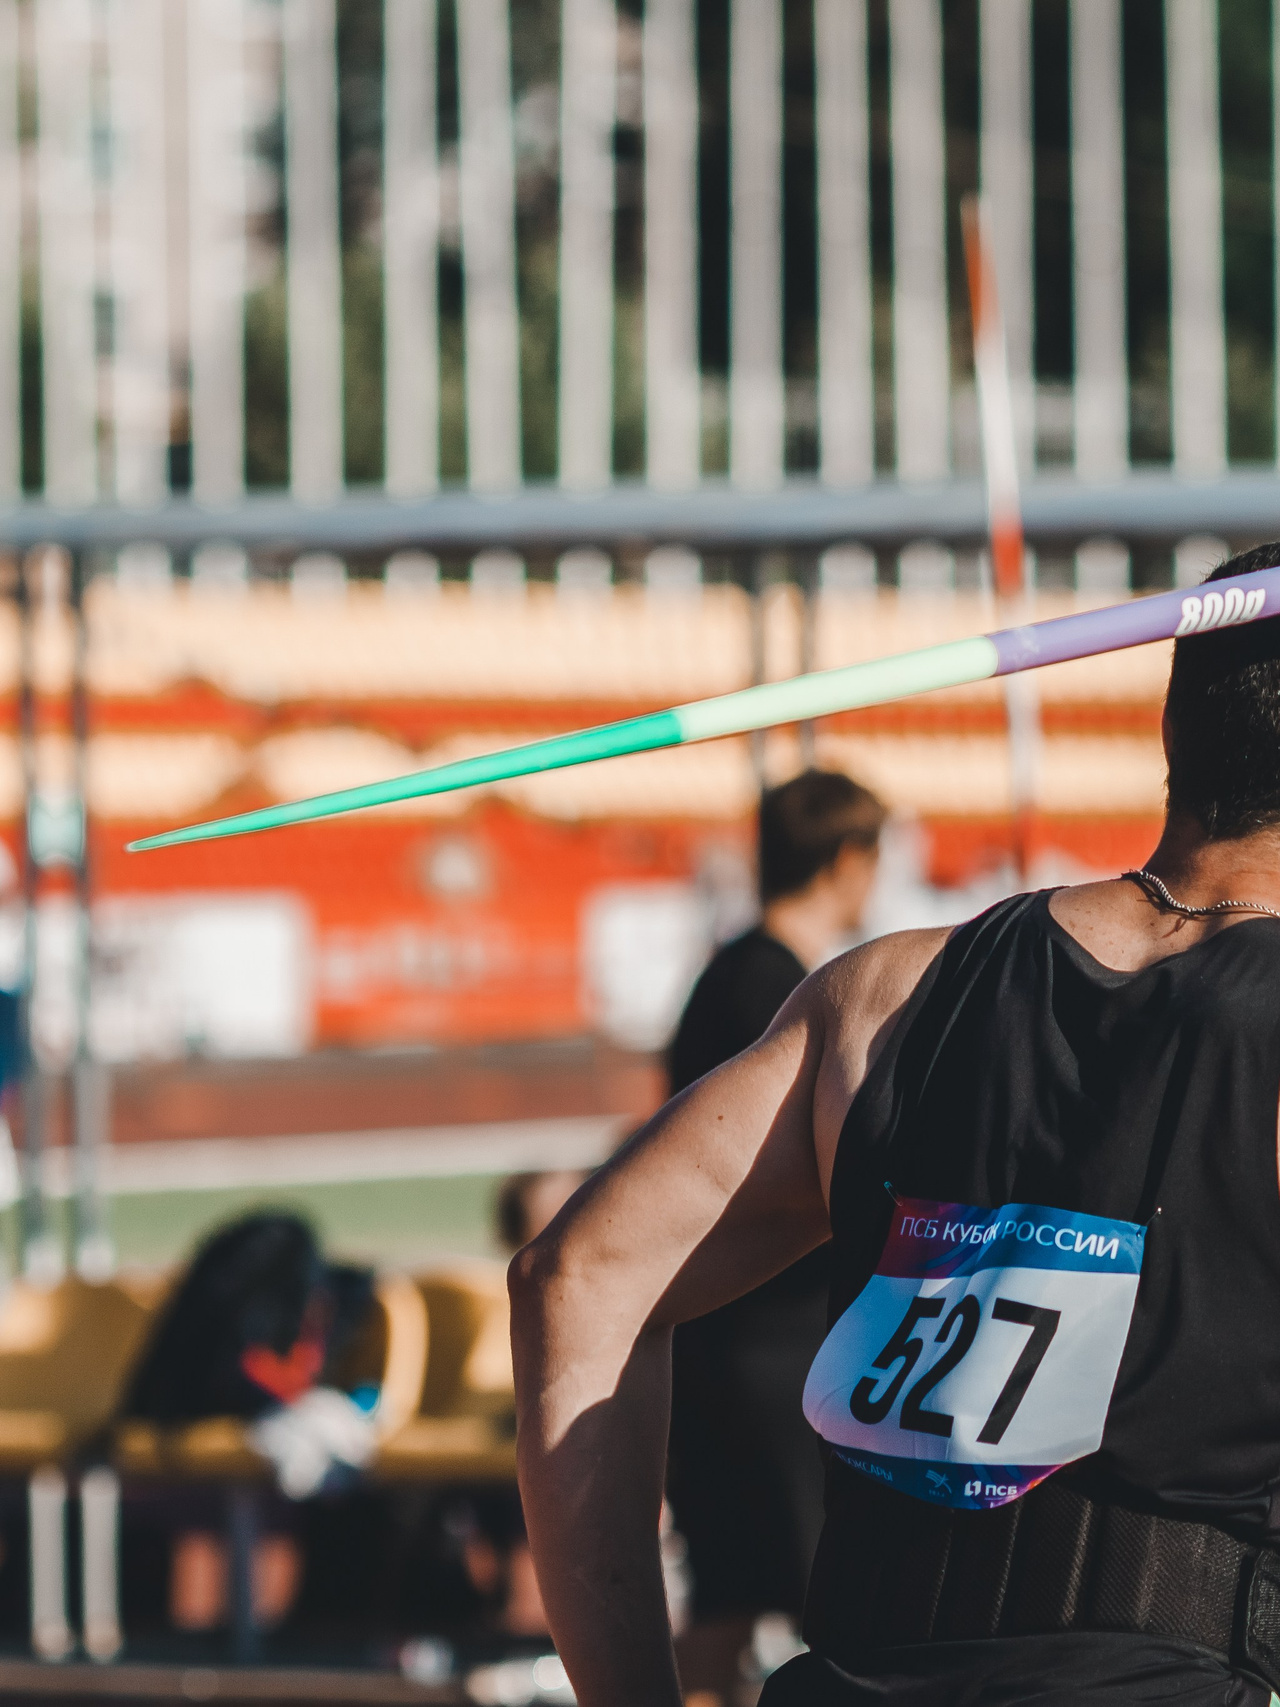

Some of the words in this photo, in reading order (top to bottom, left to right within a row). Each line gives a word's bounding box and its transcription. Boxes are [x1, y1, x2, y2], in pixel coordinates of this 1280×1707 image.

[900, 1216, 938, 1239] ПСБ
[1001, 1220, 1120, 1260] РОССИИ
[849, 1293, 1062, 1446] 527
[985, 1484, 1017, 1497] ПСБ
